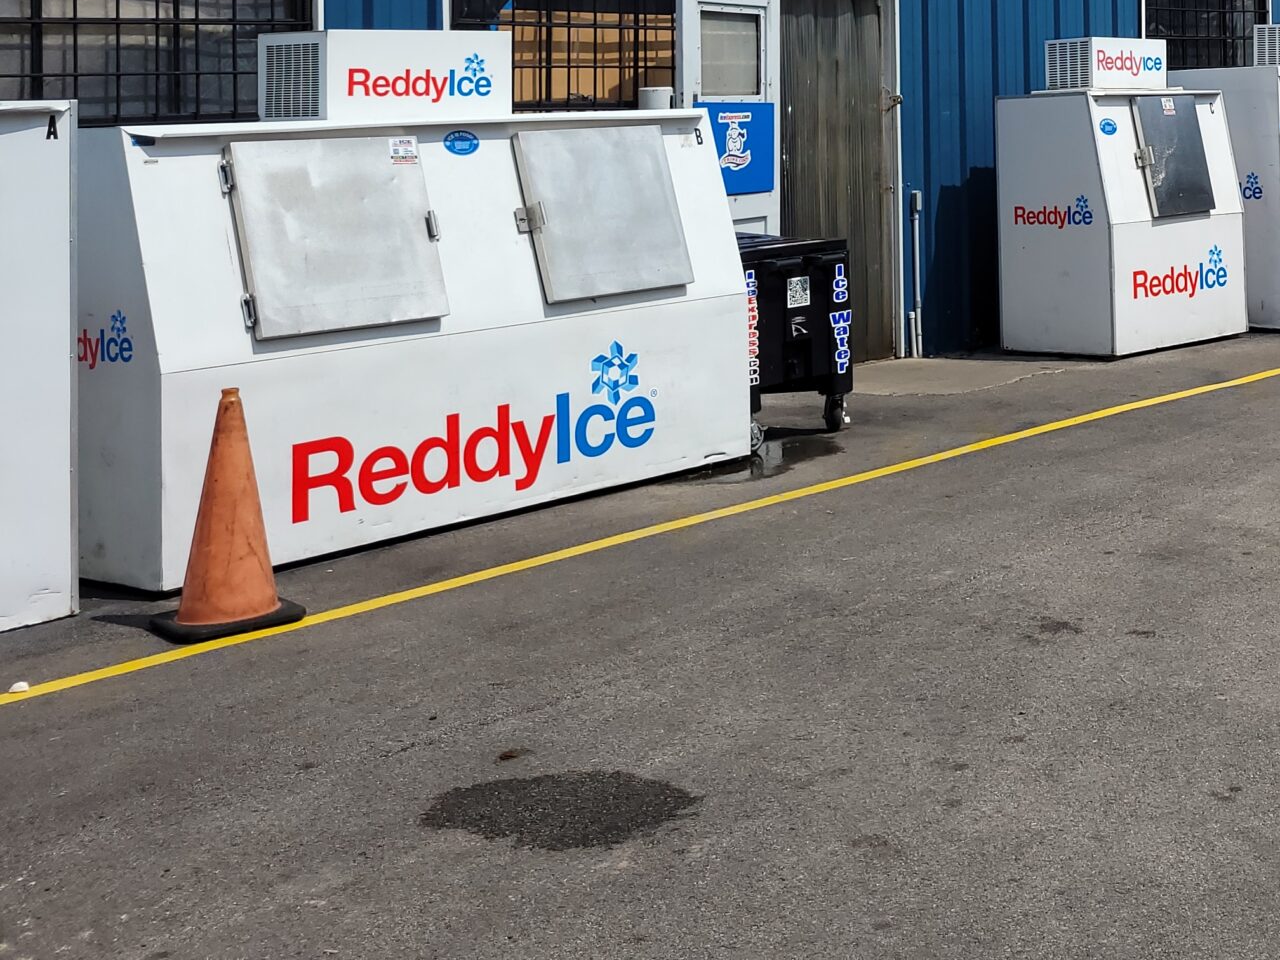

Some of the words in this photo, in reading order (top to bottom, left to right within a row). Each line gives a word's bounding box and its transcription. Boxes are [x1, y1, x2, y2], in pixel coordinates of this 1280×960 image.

[347, 68, 492, 103] ReddyIce
[46, 115, 58, 140] A
[694, 127, 704, 145] B
[1013, 205, 1093, 229] ReddyIce
[833, 264, 848, 302] Ice
[1132, 262, 1228, 299] ReddyIce
[78, 328, 133, 370] dyIce
[830, 310, 852, 374] Water
[291, 392, 656, 525] ReddyIce
